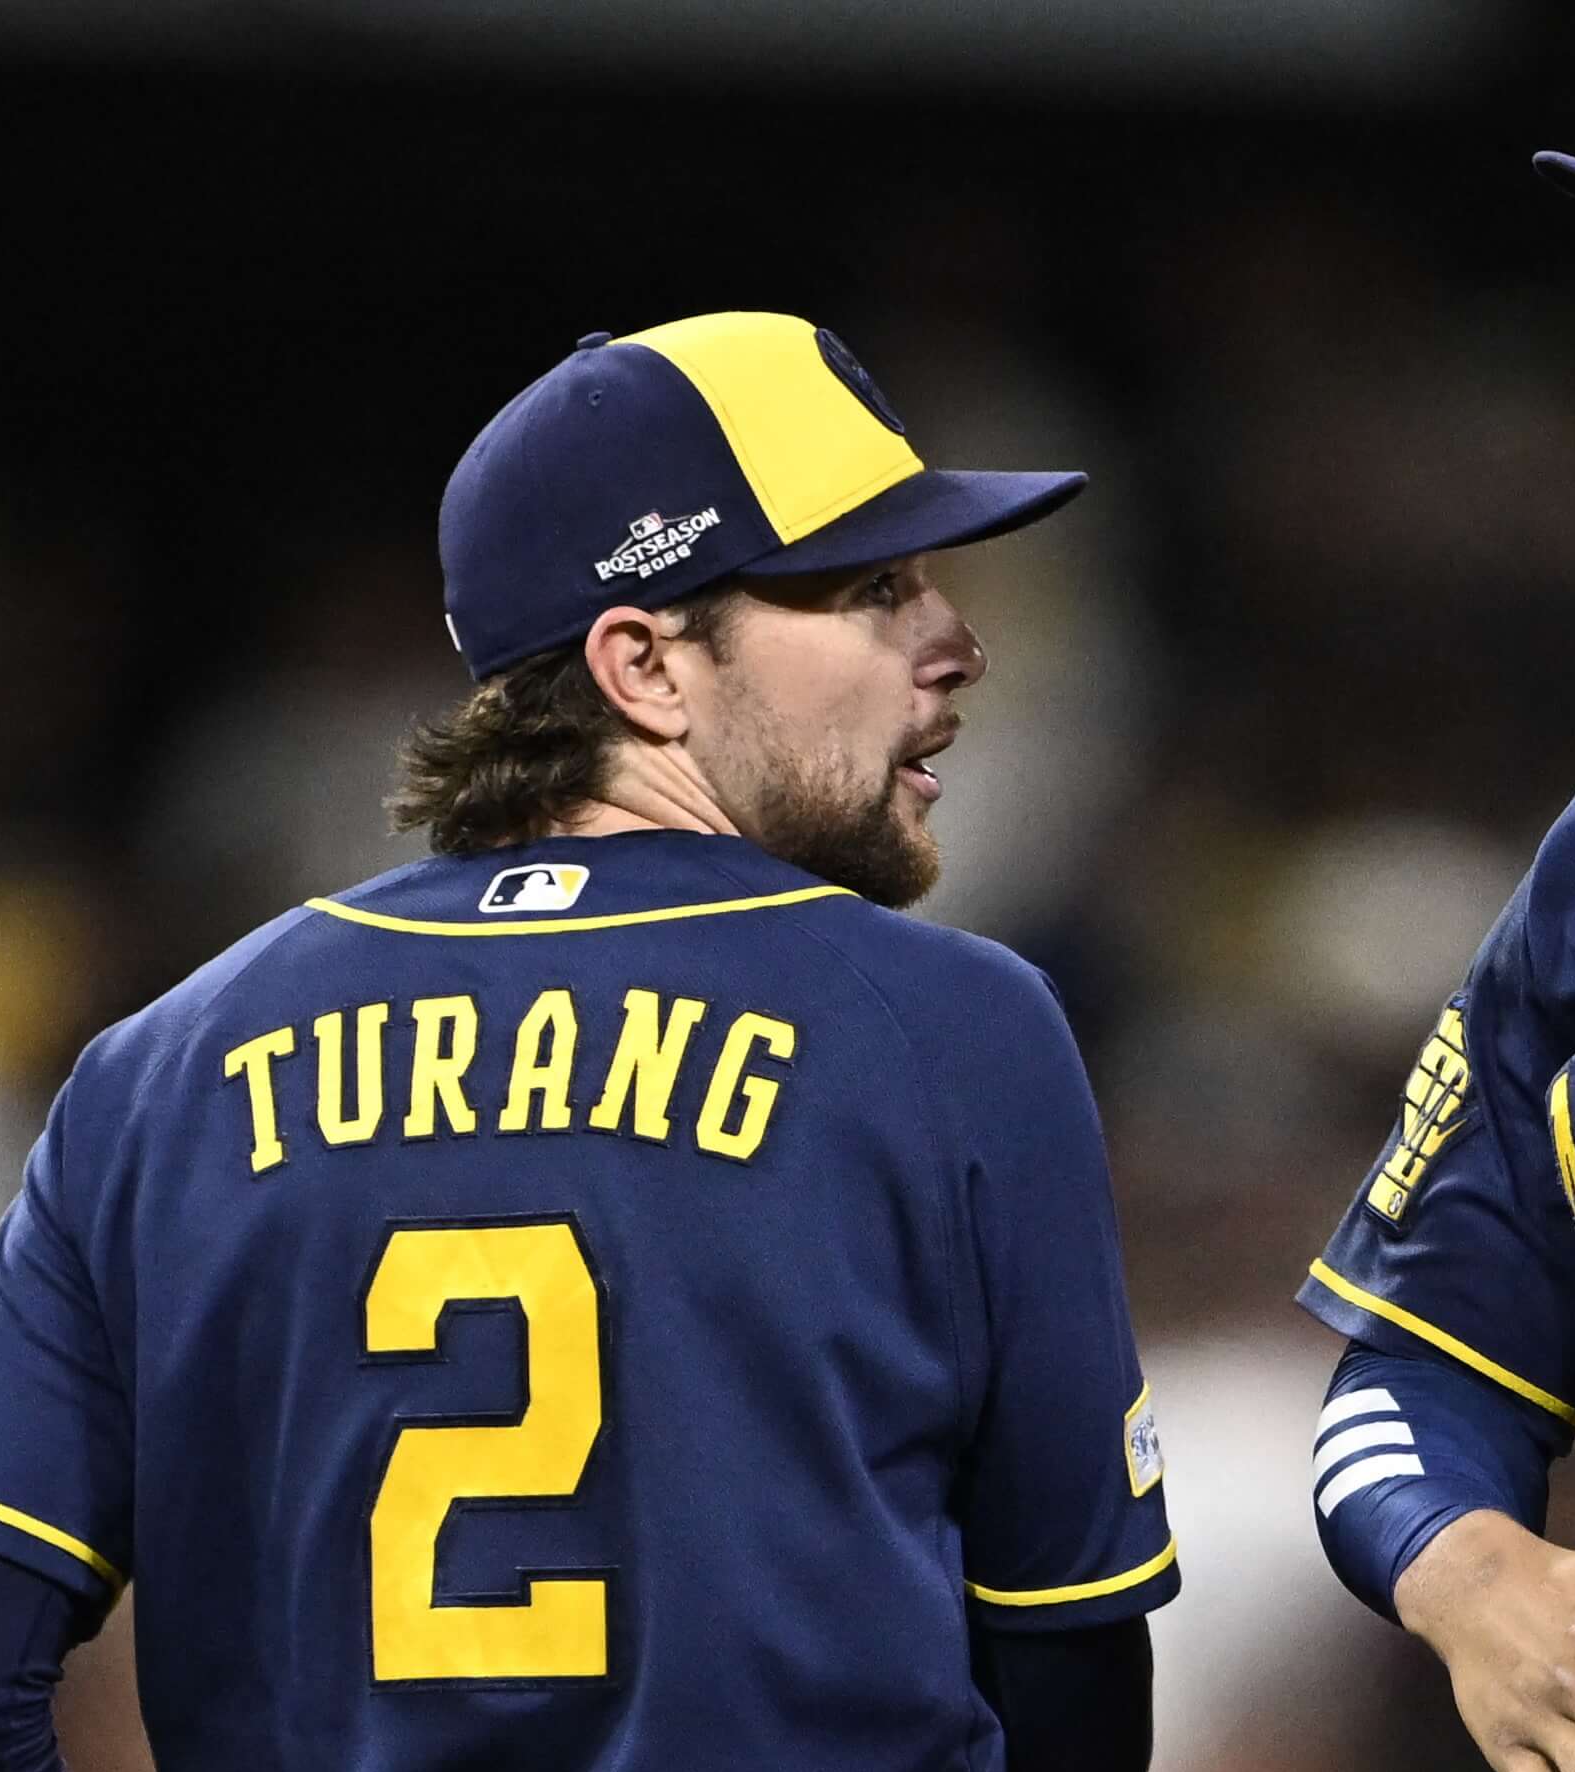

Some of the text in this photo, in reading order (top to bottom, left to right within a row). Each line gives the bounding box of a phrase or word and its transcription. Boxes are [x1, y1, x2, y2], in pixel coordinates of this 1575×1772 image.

[593, 507, 721, 580] POSTSEASON
[225, 988, 796, 1173] TURANG
[364, 1222, 608, 1682] 2
